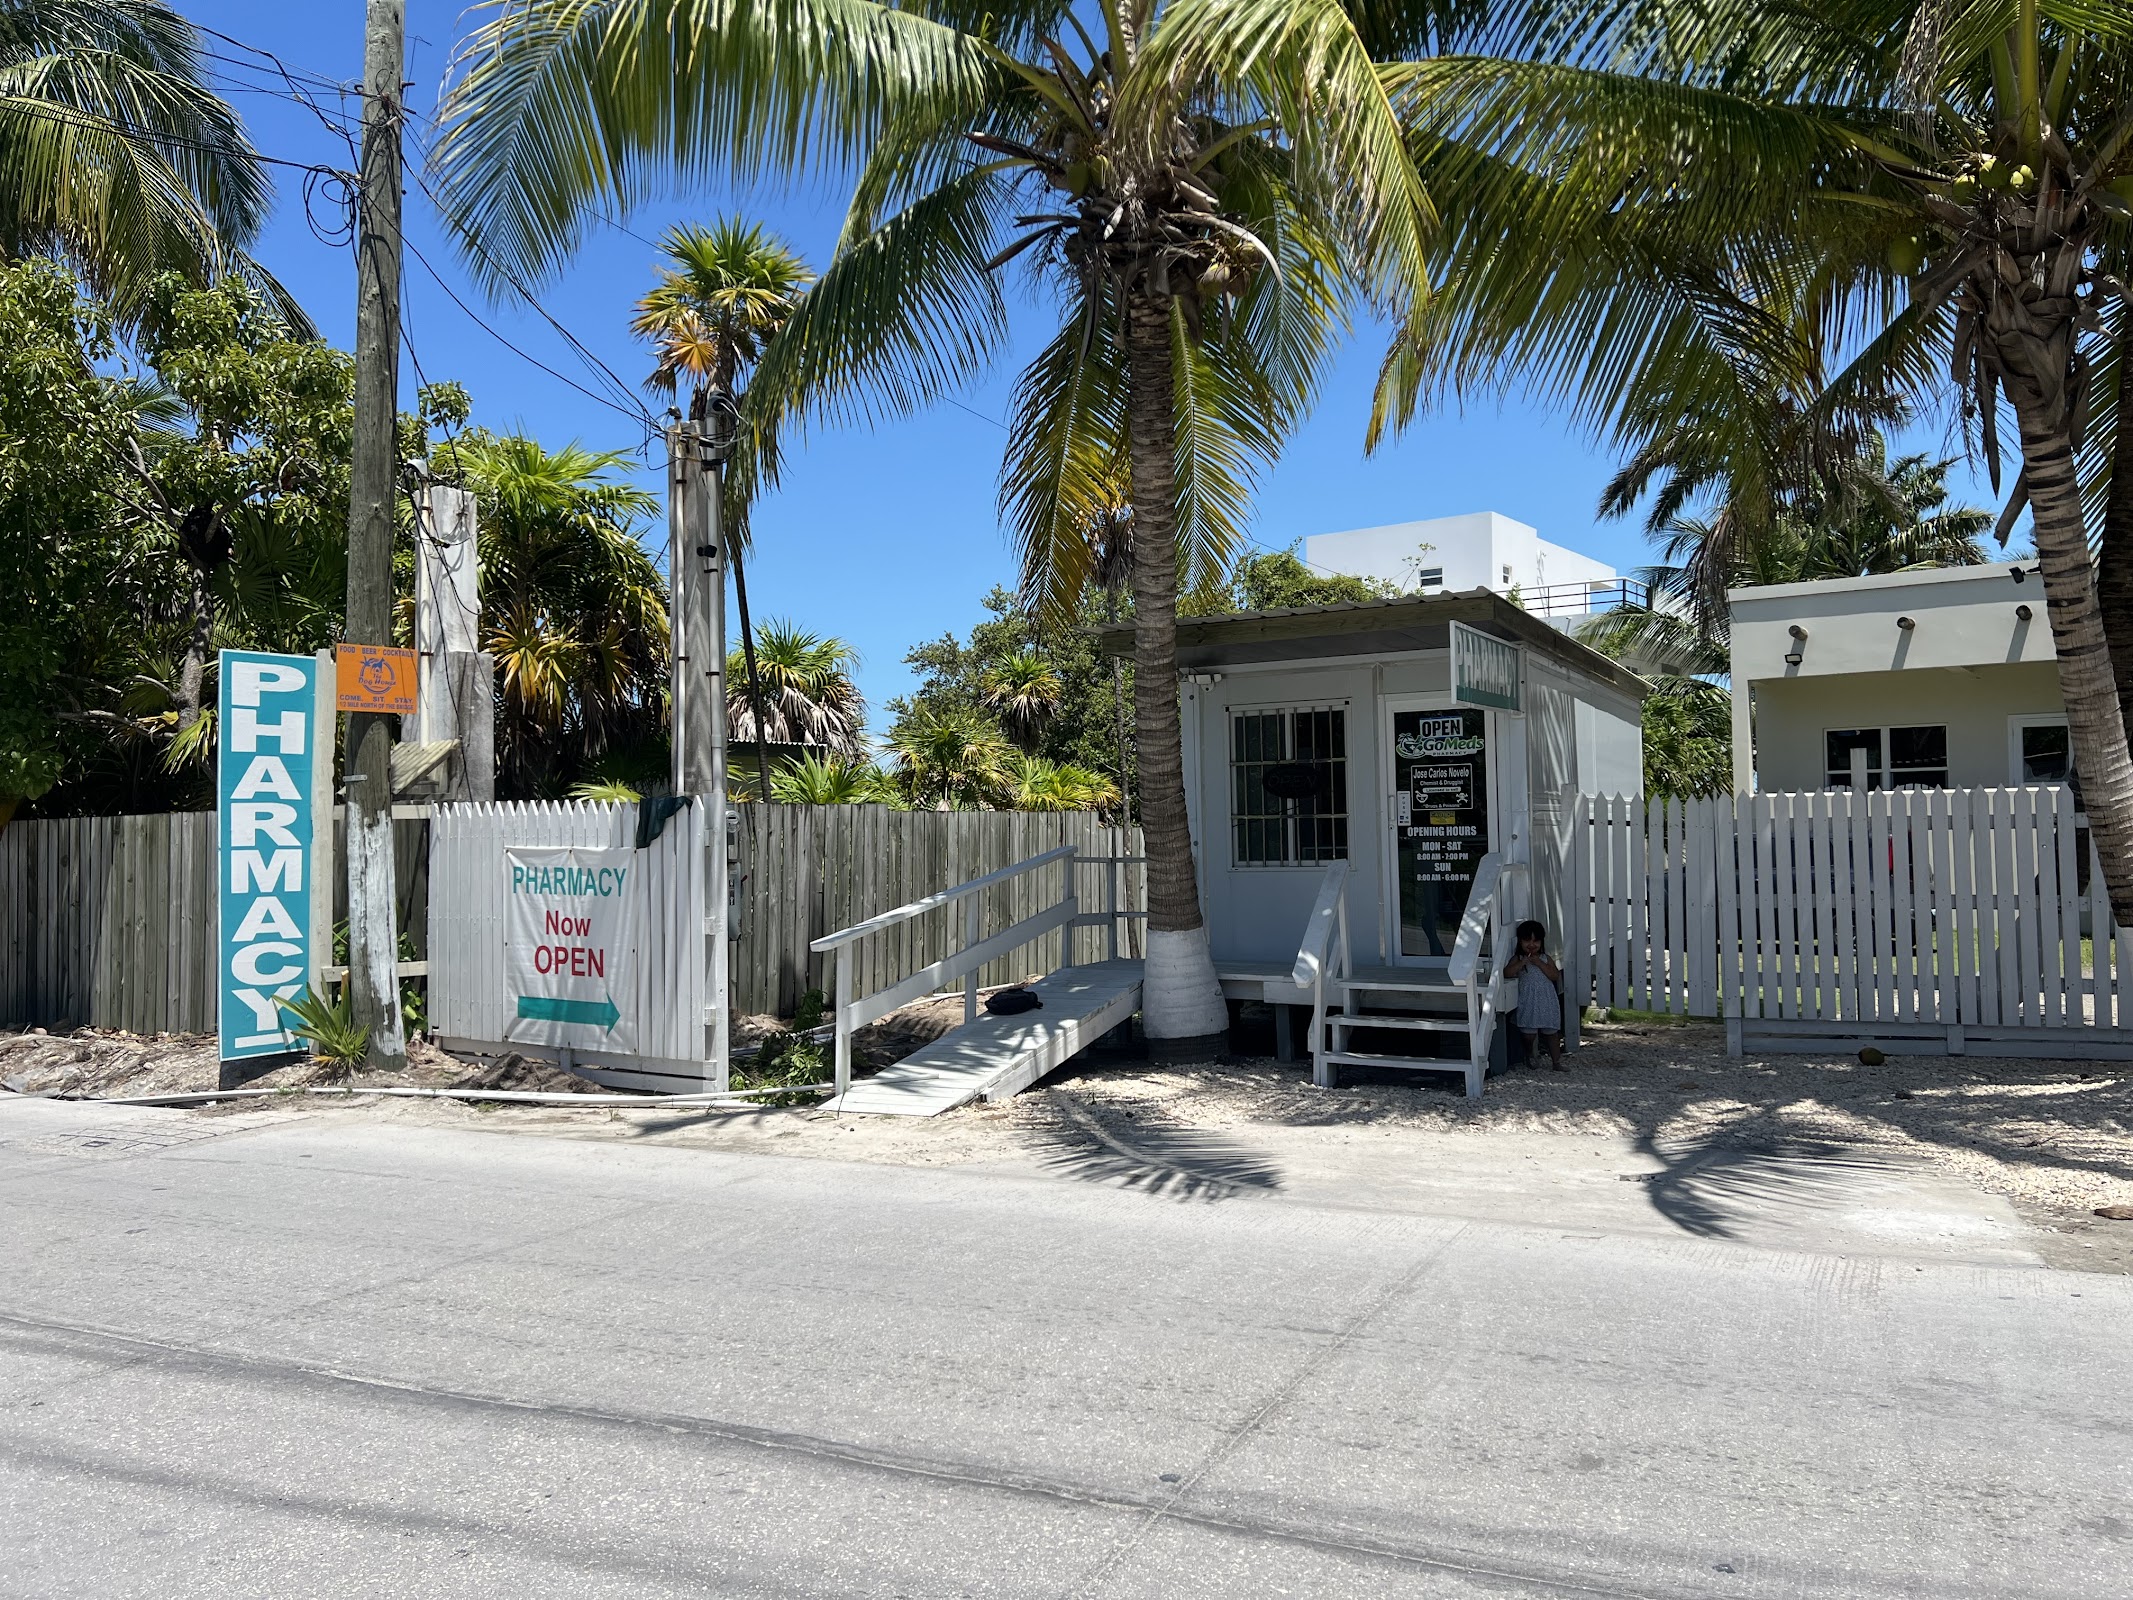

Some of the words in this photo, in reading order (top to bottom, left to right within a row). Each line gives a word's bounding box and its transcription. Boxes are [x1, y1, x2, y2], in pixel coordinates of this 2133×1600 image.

[362, 647, 377, 655] BEER
[382, 649, 414, 657] COCKTAILS
[1455, 629, 1517, 698] PHARMACY
[1422, 719, 1461, 738] OPEN
[1423, 735, 1484, 751] GoMeds
[1413, 768, 1428, 779] Jose
[1428, 767, 1448, 778] Carlos
[1448, 766, 1470, 777] Novelo
[1407, 826, 1445, 837] OPENING
[1446, 825, 1477, 836] HOURS
[230, 661, 307, 1032] PHARMACY
[1422, 841, 1441, 851] MON
[1446, 841, 1462, 851] SAT
[1458, 852, 1469, 860] PM
[1434, 862, 1452, 872] SUN
[512, 866, 627, 898] PHARMACY
[1459, 873, 1470, 881] PM
[545, 910, 592, 937] Now
[534, 945, 605, 978] OPEN
